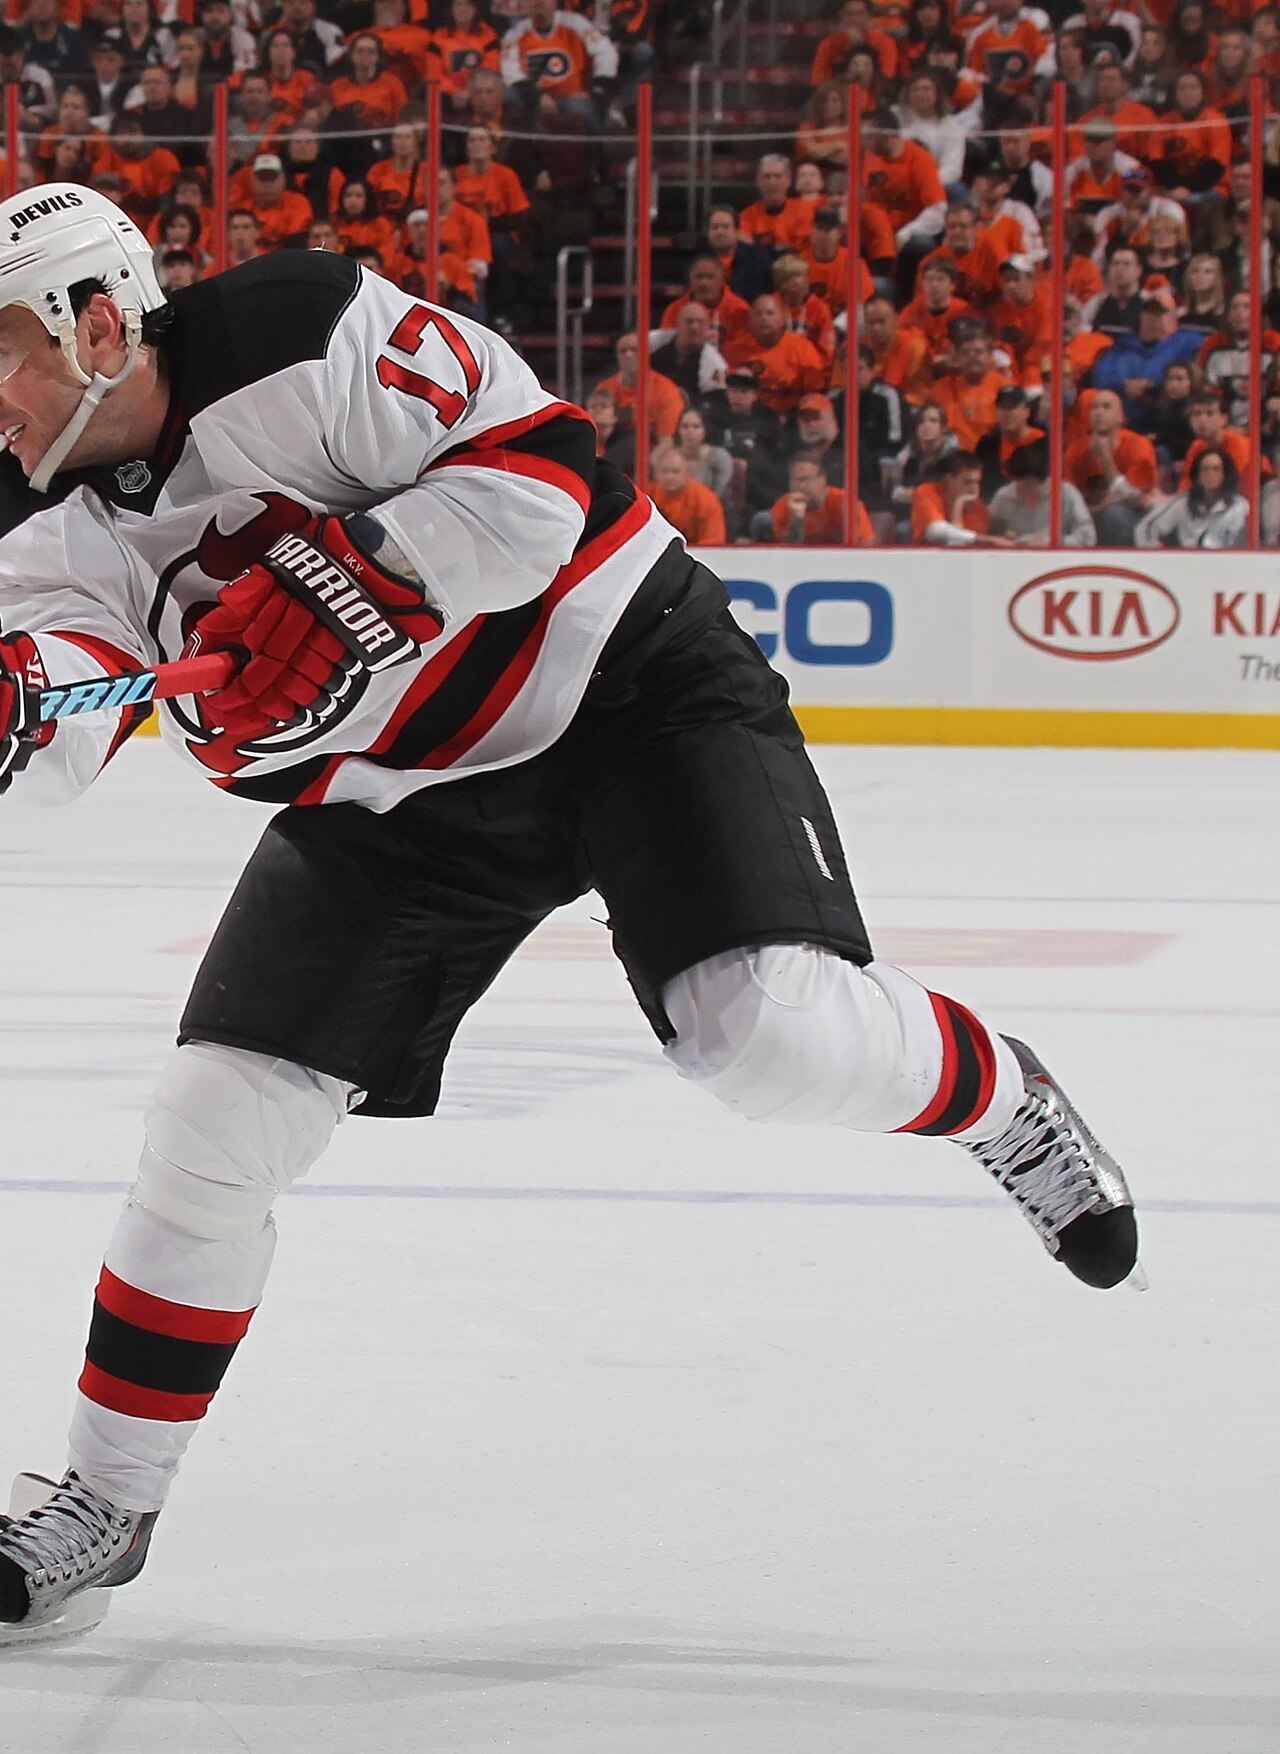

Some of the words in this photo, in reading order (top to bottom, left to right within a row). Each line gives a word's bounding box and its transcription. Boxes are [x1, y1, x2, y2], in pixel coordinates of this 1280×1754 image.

[8, 191, 83, 229] DEVILS
[375, 303, 482, 430] 17
[1040, 590, 1151, 638] KIA
